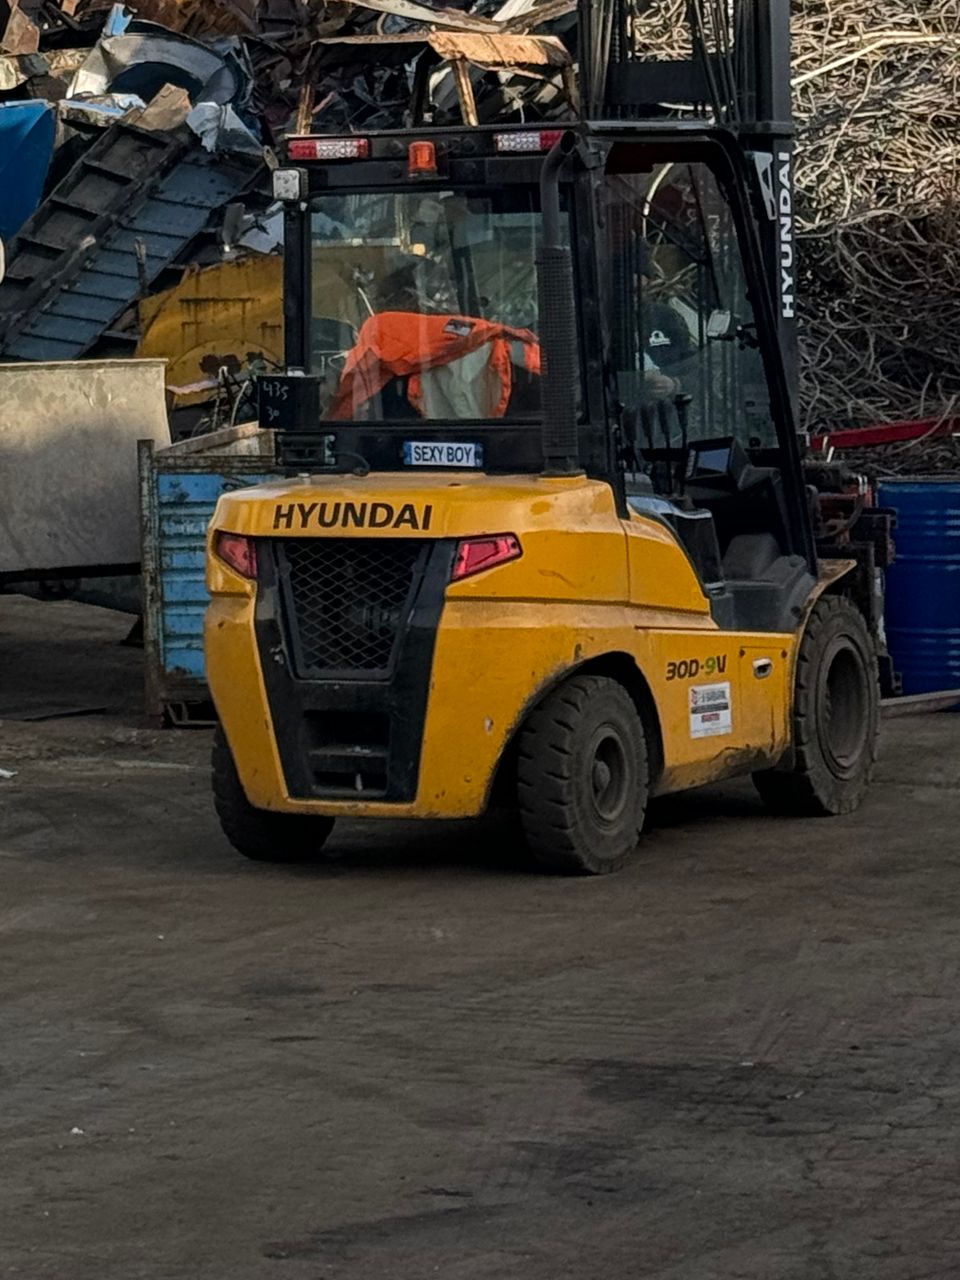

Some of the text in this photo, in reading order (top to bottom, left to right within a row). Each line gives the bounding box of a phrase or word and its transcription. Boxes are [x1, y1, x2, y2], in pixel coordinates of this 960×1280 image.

[778, 152, 794, 317] HYUNDAI
[414, 445, 472, 463] SEXY BOY
[273, 502, 433, 531] HYUNDAI
